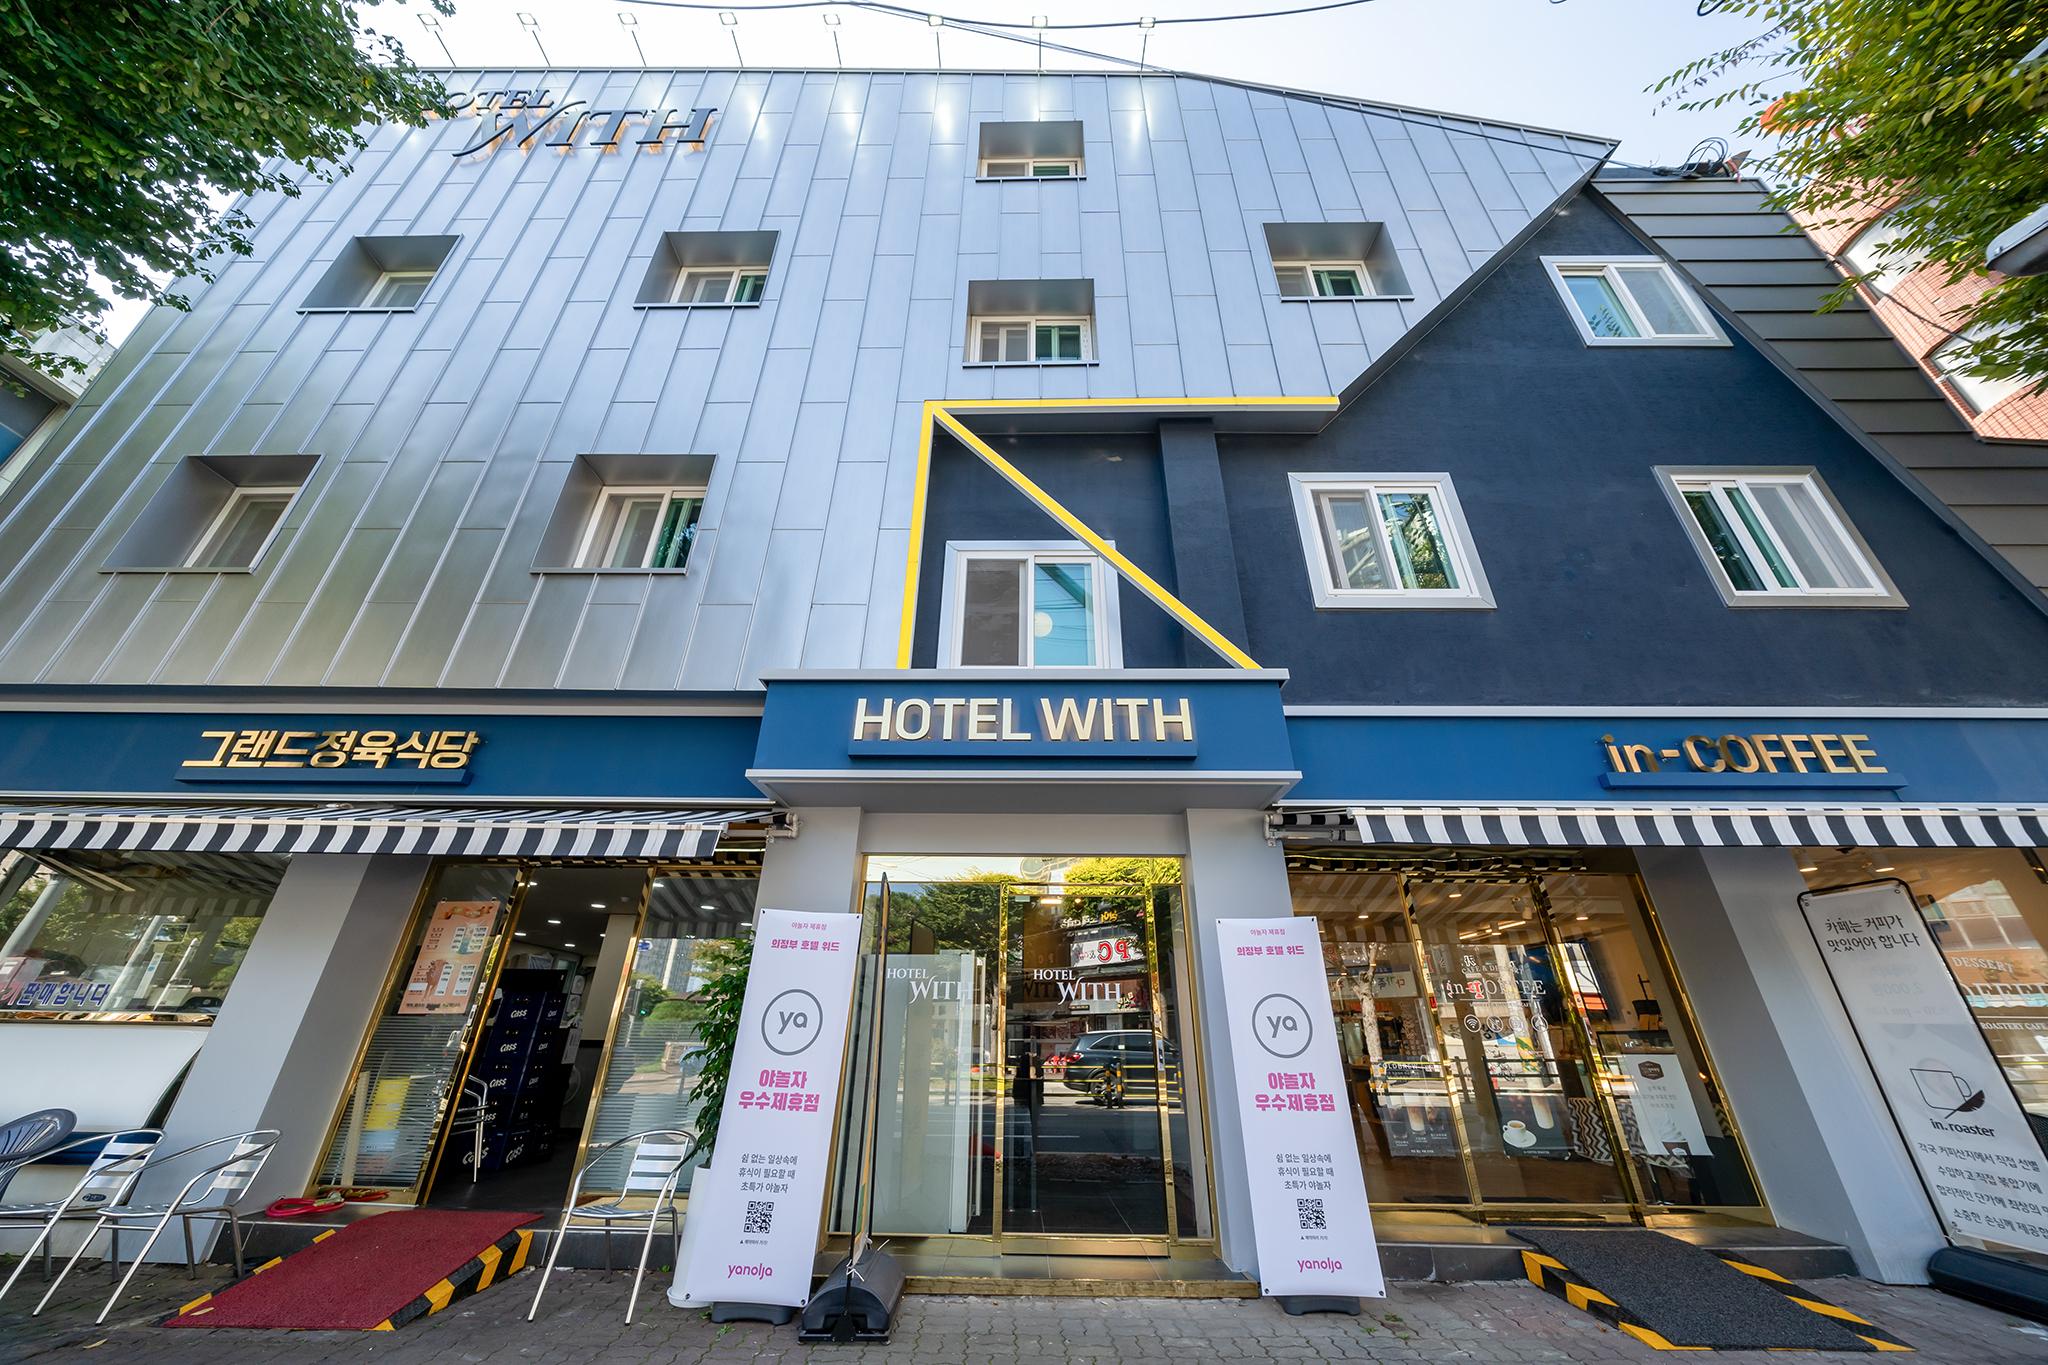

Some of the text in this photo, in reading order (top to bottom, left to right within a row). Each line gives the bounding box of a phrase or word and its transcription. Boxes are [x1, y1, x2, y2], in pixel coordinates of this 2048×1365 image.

[421, 89, 555, 111] OTEL
[452, 100, 718, 157] WITH
[852, 697, 1193, 741] HOTEL WITH
[181, 730, 480, 769] 그랜드정육식당
[1600, 734, 1889, 774] in-COFFEE
[1825, 915, 1904, 934] 카페는 커피가
[771, 939, 840, 951] 의정부 호텔 위드
[1237, 945, 1304, 956] 의정부 호텔 위드
[1827, 932, 1920, 952] 맛있어야 합니다
[887, 968, 929, 979] HOTEL
[1033, 969, 1075, 980] HOTEL
[17, 982, 111, 1006] 판매합니다
[910, 975, 970, 1005] WITH
[1056, 976, 1121, 1006] WITH
[511, 1009, 528, 1019] Cass
[777, 1011, 807, 1035] ya
[1266, 1013, 1298, 1038] ya
[500, 1043, 518, 1053] Cass
[489, 1078, 507, 1088] Cass
[759, 1069, 807, 1089] 야놀자
[1267, 1072, 1316, 1090] 야놀자
[738, 1091, 820, 1112] 우수제휴점
[1255, 1093, 1336, 1111] 우수제휴점
[462, 1147, 490, 1165] Cas
[751, 1153, 766, 1164] 없는
[768, 1154, 798, 1165] 일상속에
[1285, 1154, 1300, 1163] 없는
[1301, 1154, 1332, 1163] 일상속에
[739, 1167, 795, 1179] 휴식이 필요할 때
[1278, 1167, 1300, 1176] 휴식이
[1302, 1167, 1324, 1176] 필요할
[740, 1181, 788, 1193] 초특가 야놀자
[1284, 1180, 1331, 1190] 초특가 야놀자
[727, 1263, 773, 1279] yanolja
[1297, 1257, 1342, 1273] yanolja
